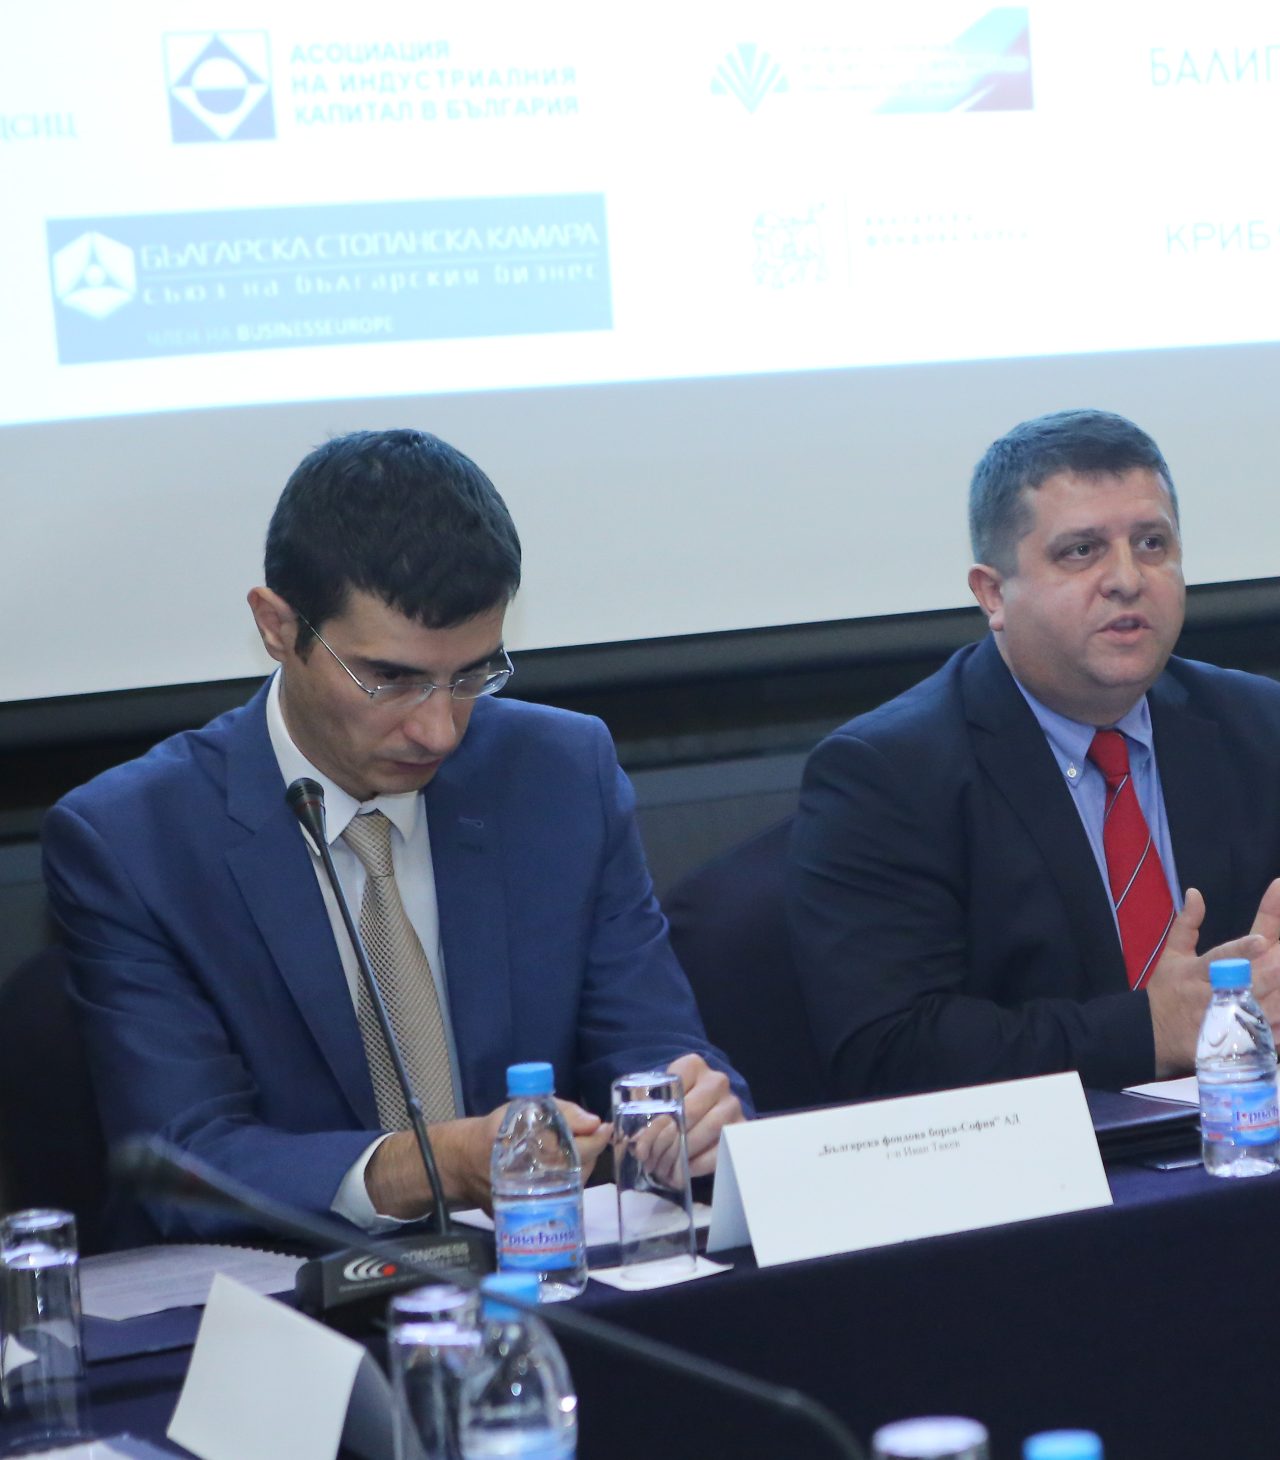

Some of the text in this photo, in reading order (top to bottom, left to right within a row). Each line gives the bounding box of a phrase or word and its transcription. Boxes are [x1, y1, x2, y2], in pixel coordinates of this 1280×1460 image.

[290, 40, 450, 65] АСОЦИАЦИЯ
[291, 66, 577, 96] НА ИНДУСТРИАЛНИЯ
[295, 94, 579, 126] КАПИТАЛ В БЪЛГАРИЯ
[140, 221, 599, 268] БЪЛГАРСКА СТОПАНСКА КАМАРА
[1164, 219, 1273, 255] КРИБ
[1003, 1113, 1021, 1125] АД
